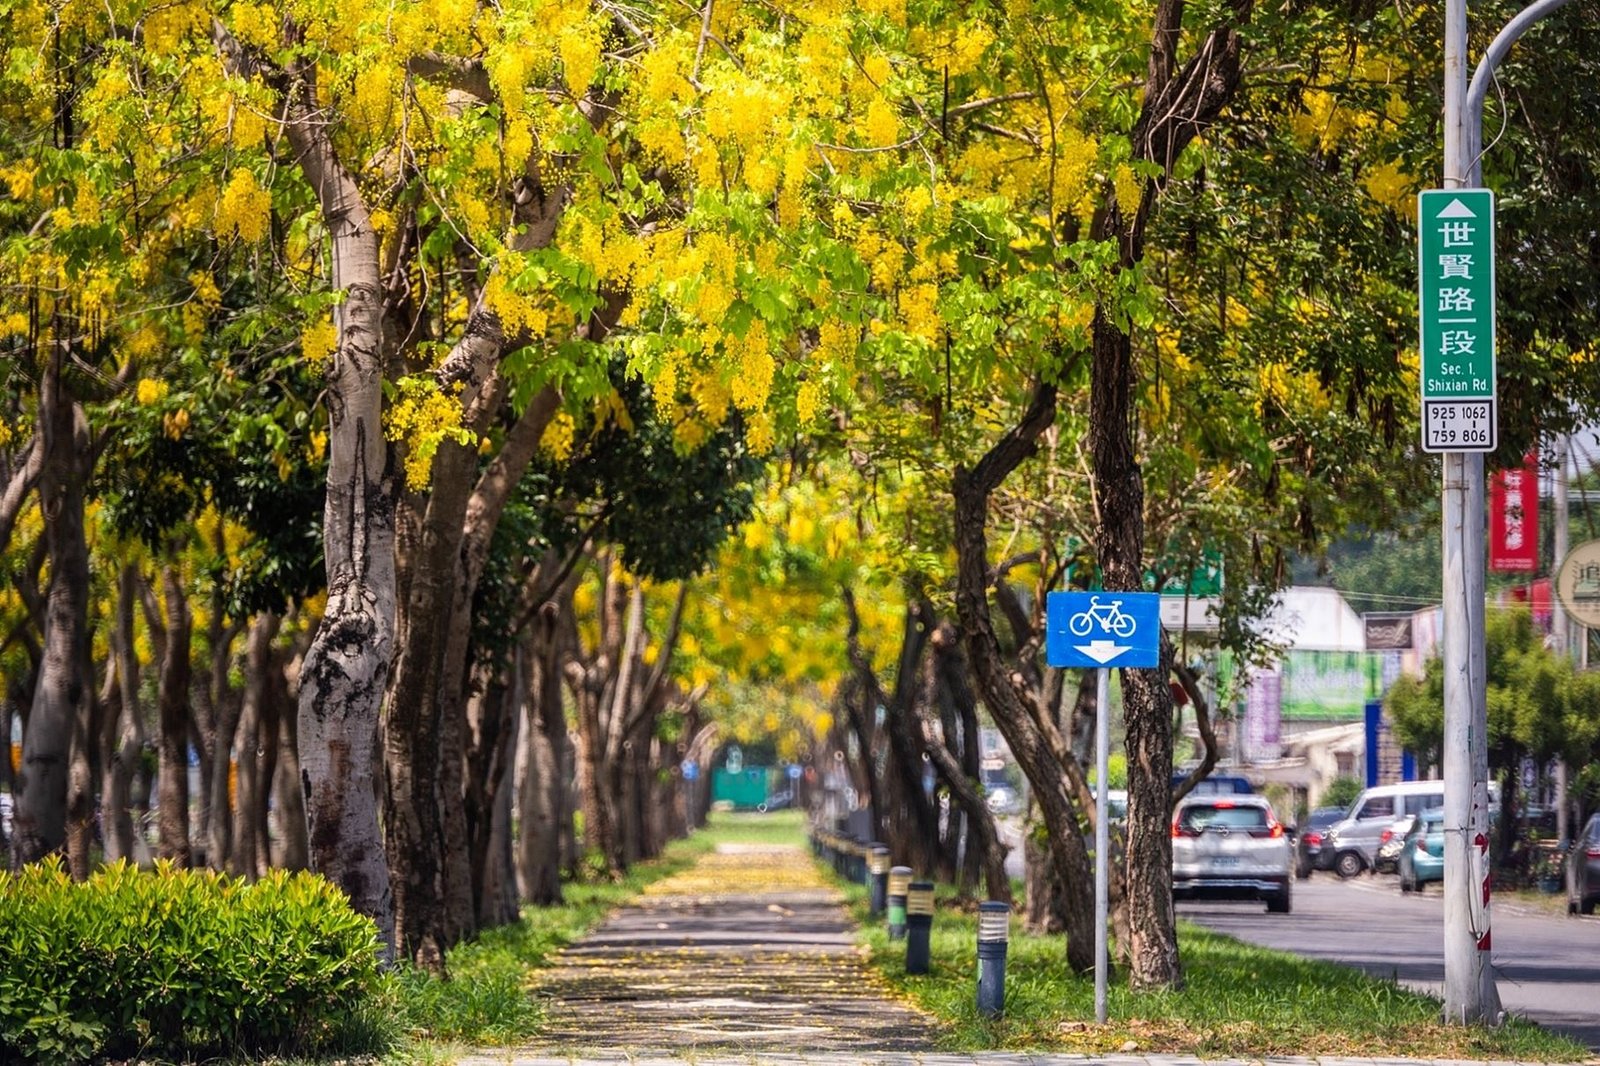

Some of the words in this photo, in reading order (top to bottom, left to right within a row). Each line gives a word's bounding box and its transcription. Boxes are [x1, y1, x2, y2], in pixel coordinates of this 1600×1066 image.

[1437, 222, 1477, 355] 世賢路一段
[1441, 362, 1464, 375] Sec.
[1428, 378, 1468, 391] Shixian
[1473, 378, 1489, 391] Rd.
[1432, 407, 1456, 419] 925
[1462, 407, 1486, 419] 1062
[1432, 430, 1456, 442] 759
[1462, 430, 1486, 442] 806
